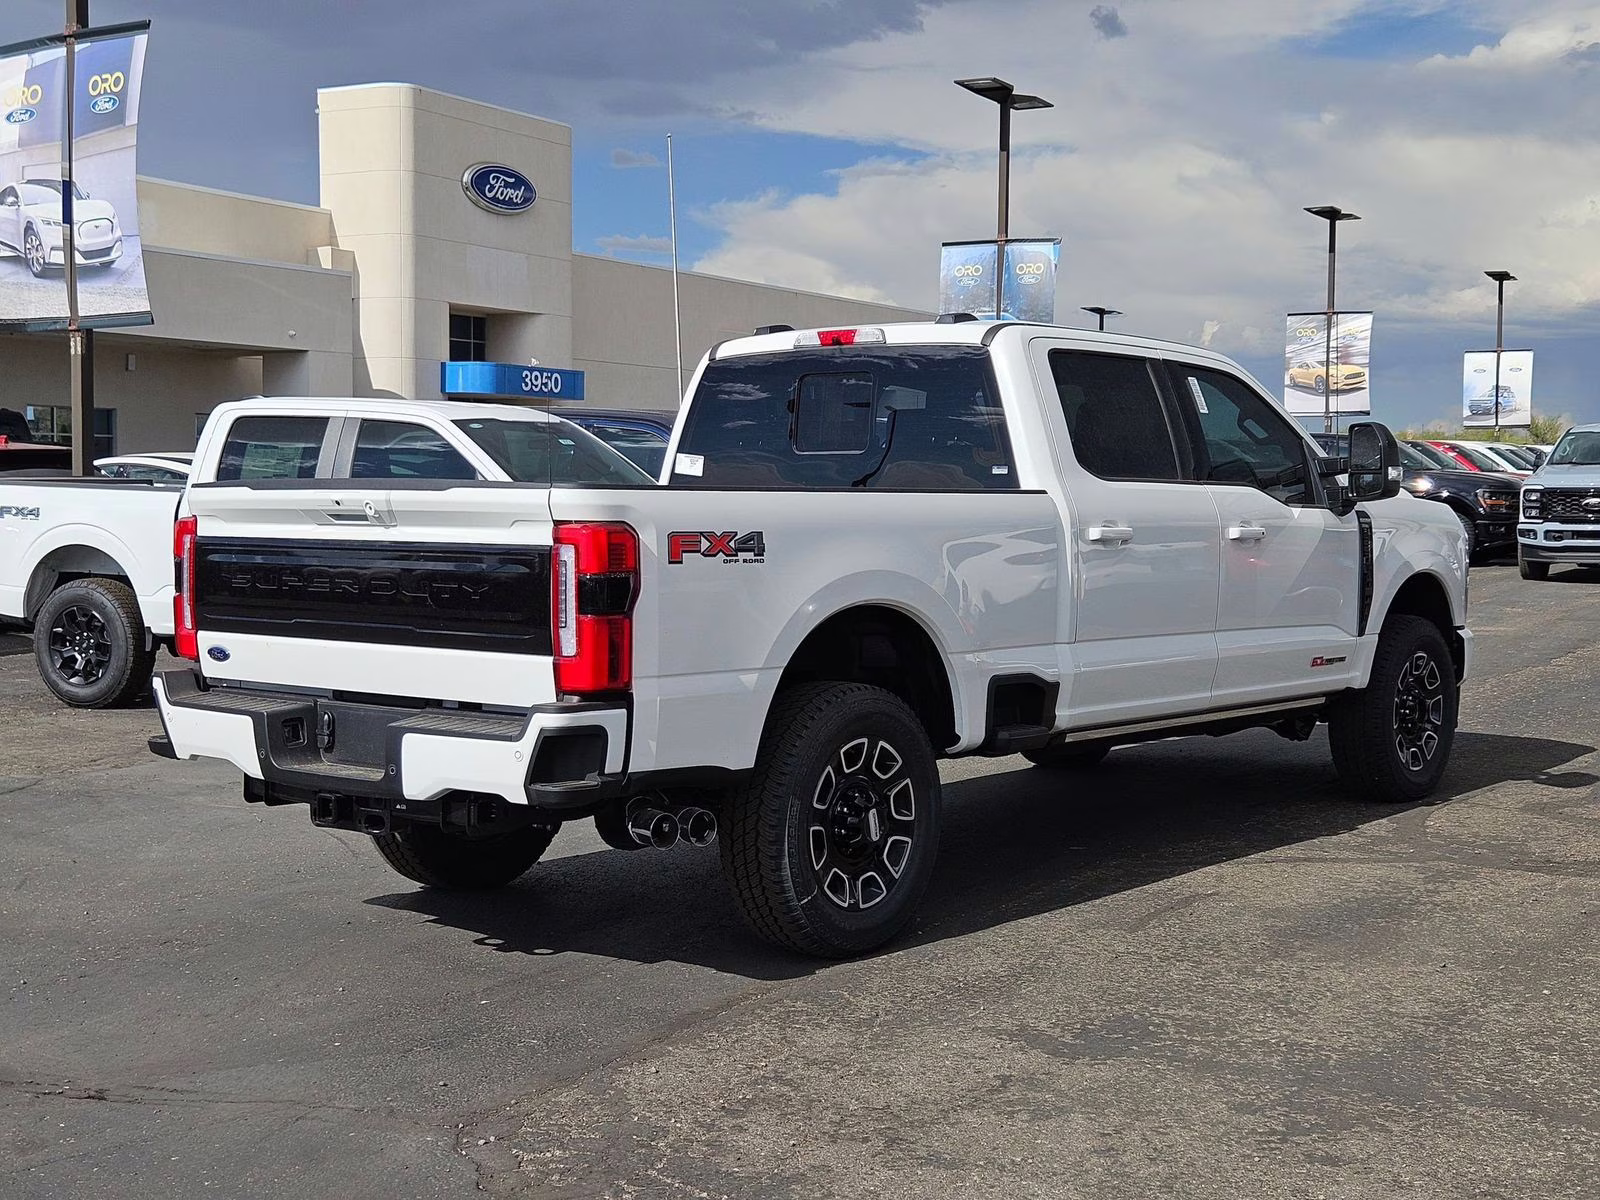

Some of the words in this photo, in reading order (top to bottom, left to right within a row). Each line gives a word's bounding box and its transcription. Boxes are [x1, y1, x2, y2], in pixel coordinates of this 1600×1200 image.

[5, 84, 43, 107] ORO
[88, 71, 125, 96] ORO
[485, 173, 525, 203] Ford
[954, 265, 983, 277] ORO
[1016, 263, 1044, 275] ORO
[1296, 328, 1317, 337] ORO
[521, 370, 562, 394] 3950
[667, 531, 766, 565] FX4
[231, 574, 359, 593] SUPER
[370, 580, 490, 599] DUTY
